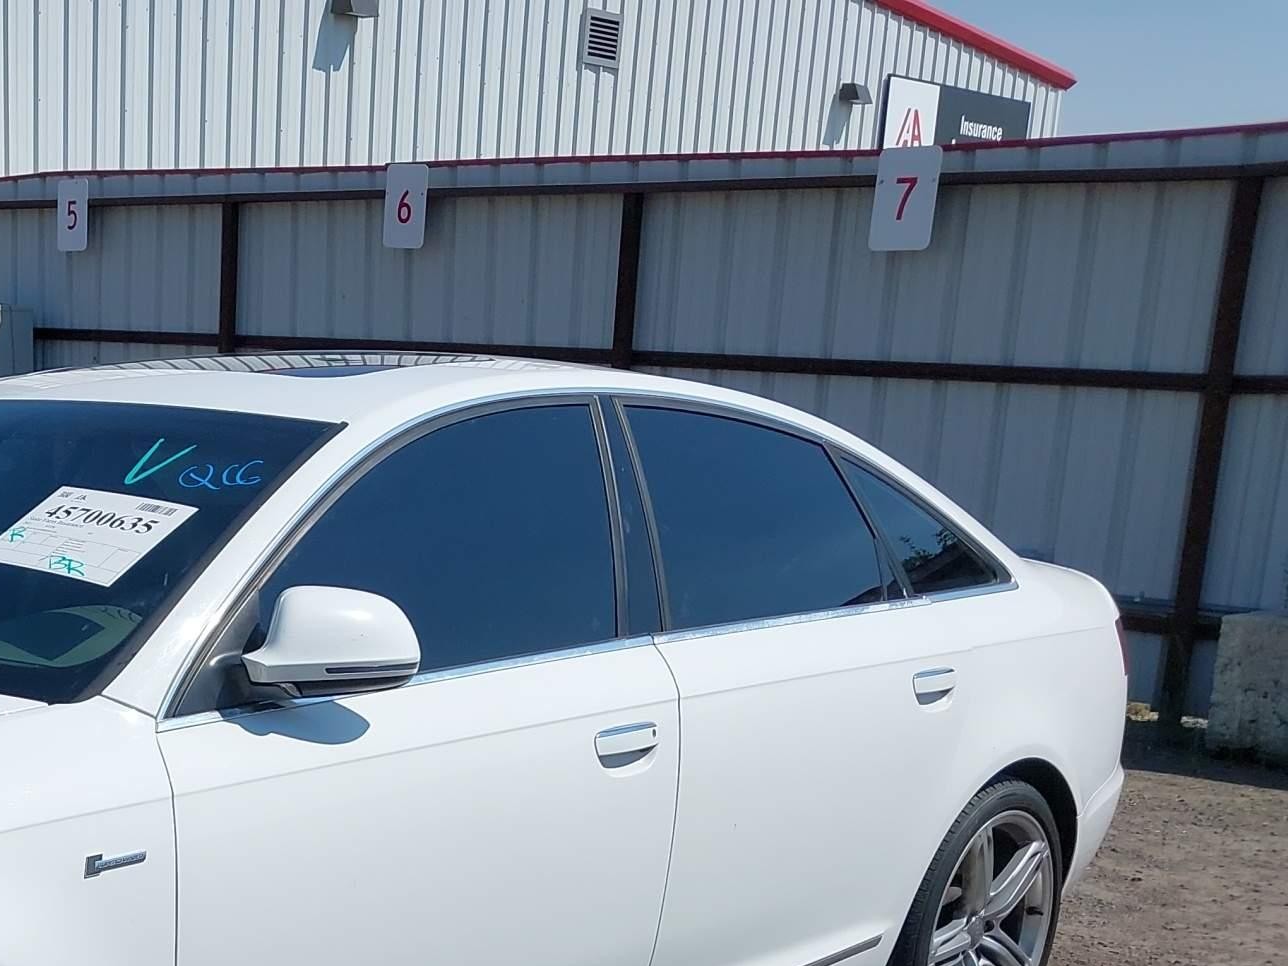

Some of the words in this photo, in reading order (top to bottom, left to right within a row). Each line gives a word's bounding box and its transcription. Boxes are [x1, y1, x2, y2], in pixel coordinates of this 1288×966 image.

[960, 115, 1003, 141] Insurance
[397, 189, 412, 224] 6
[895, 177, 918, 221] 7
[67, 200, 78, 231] 5
[45, 505, 160, 534] 45700635
